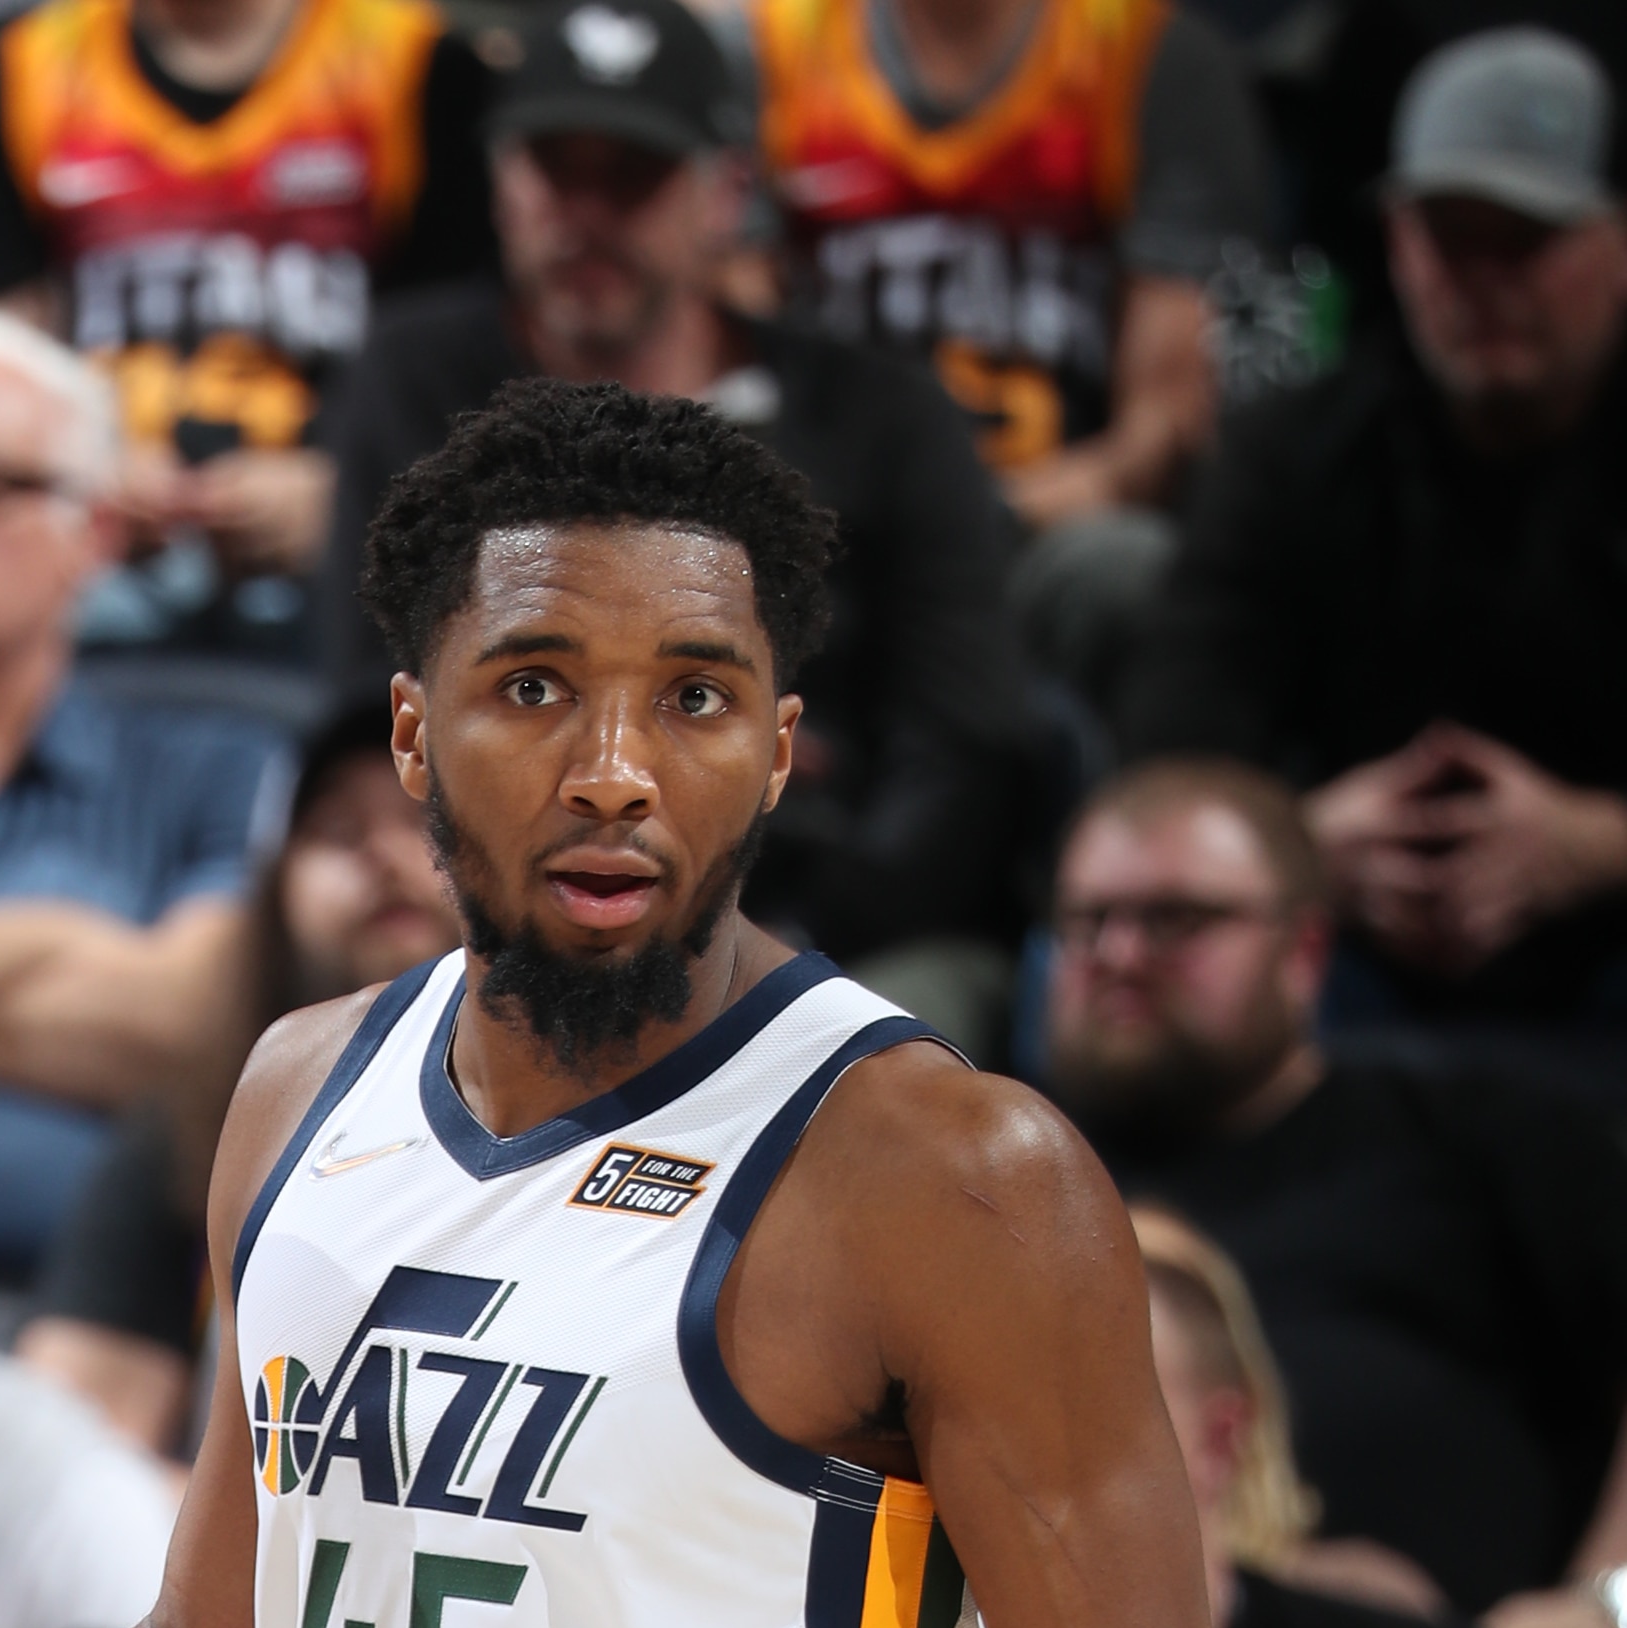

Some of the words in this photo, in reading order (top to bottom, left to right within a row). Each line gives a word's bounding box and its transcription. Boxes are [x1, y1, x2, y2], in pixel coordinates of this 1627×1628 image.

[582, 1152, 635, 1201] 5
[641, 1159, 673, 1175] FOR
[670, 1165, 701, 1181] THE
[614, 1183, 691, 1212] FIGHT
[255, 1265, 608, 1532] JAZZ
